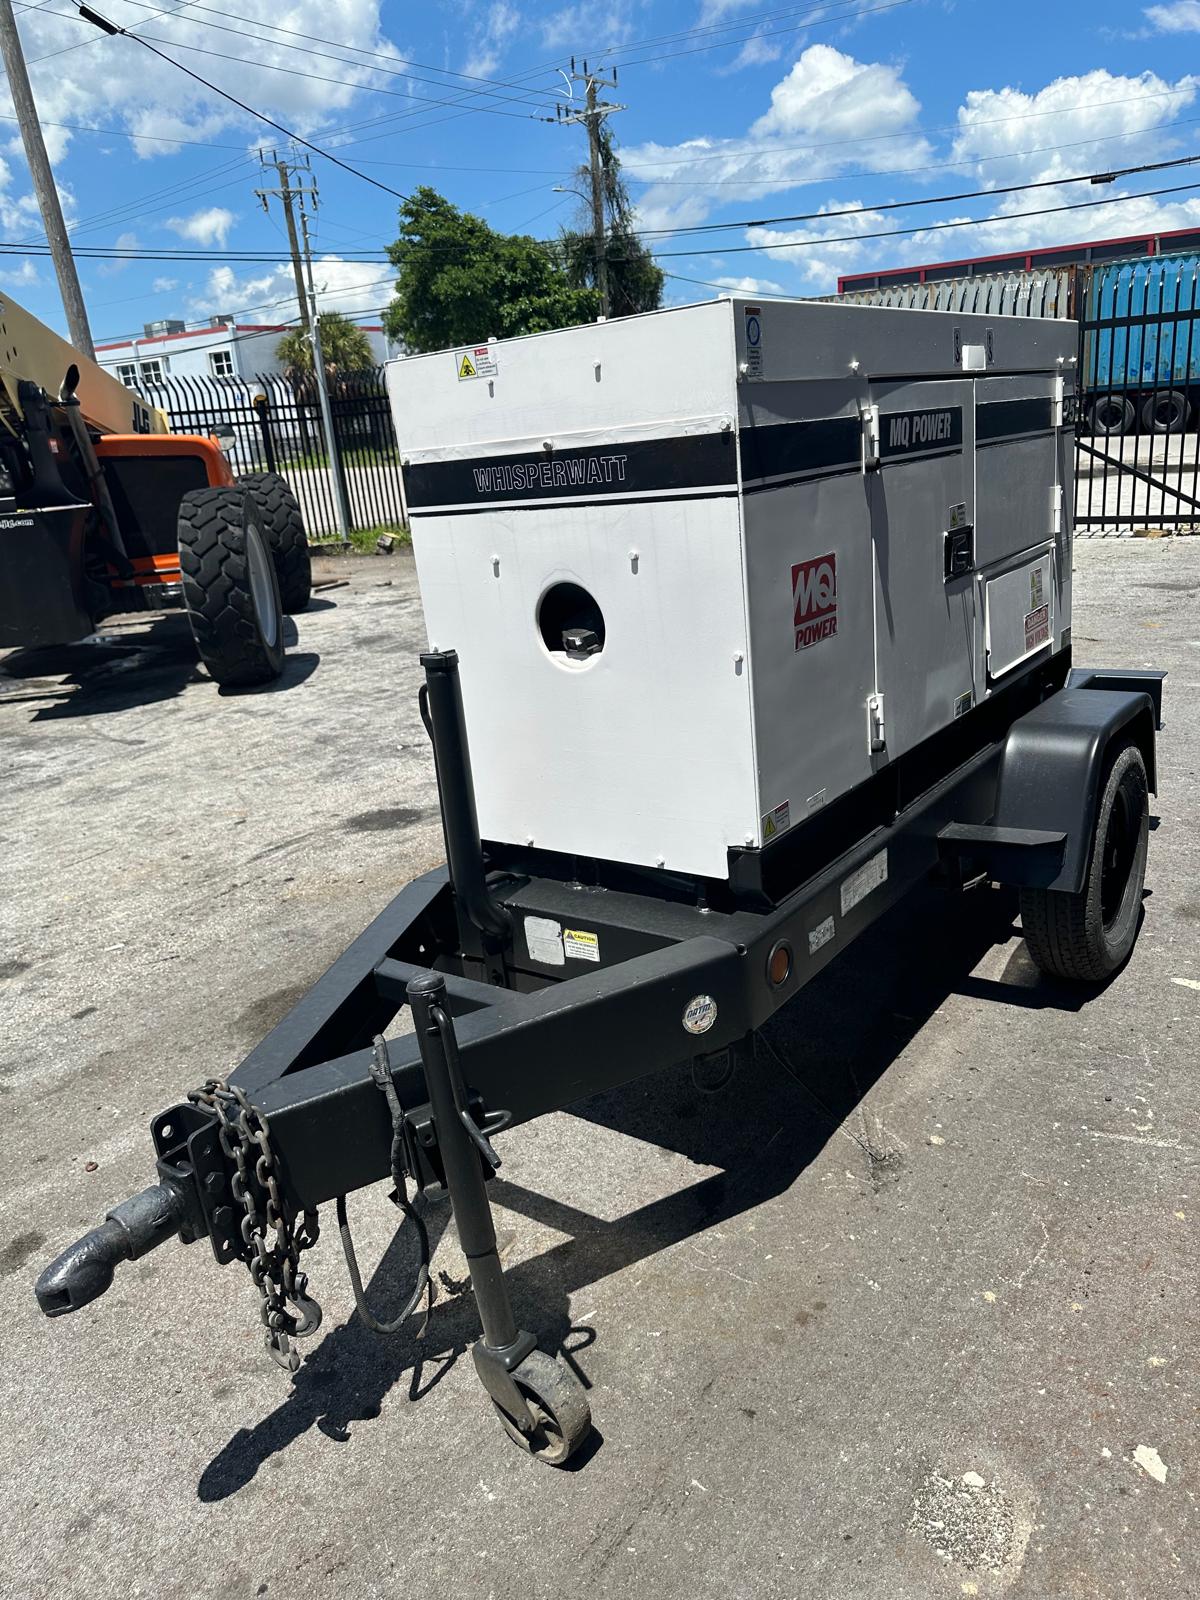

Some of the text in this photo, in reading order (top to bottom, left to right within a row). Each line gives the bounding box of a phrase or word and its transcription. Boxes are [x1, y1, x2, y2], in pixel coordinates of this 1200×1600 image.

[132, 401, 150, 434] JLG
[889, 412, 952, 448] MQ POWER
[473, 454, 628, 493] WHISPERWATT
[793, 562, 837, 617] MQ
[795, 616, 837, 650] POWER
[574, 933, 596, 942] CAUTION
